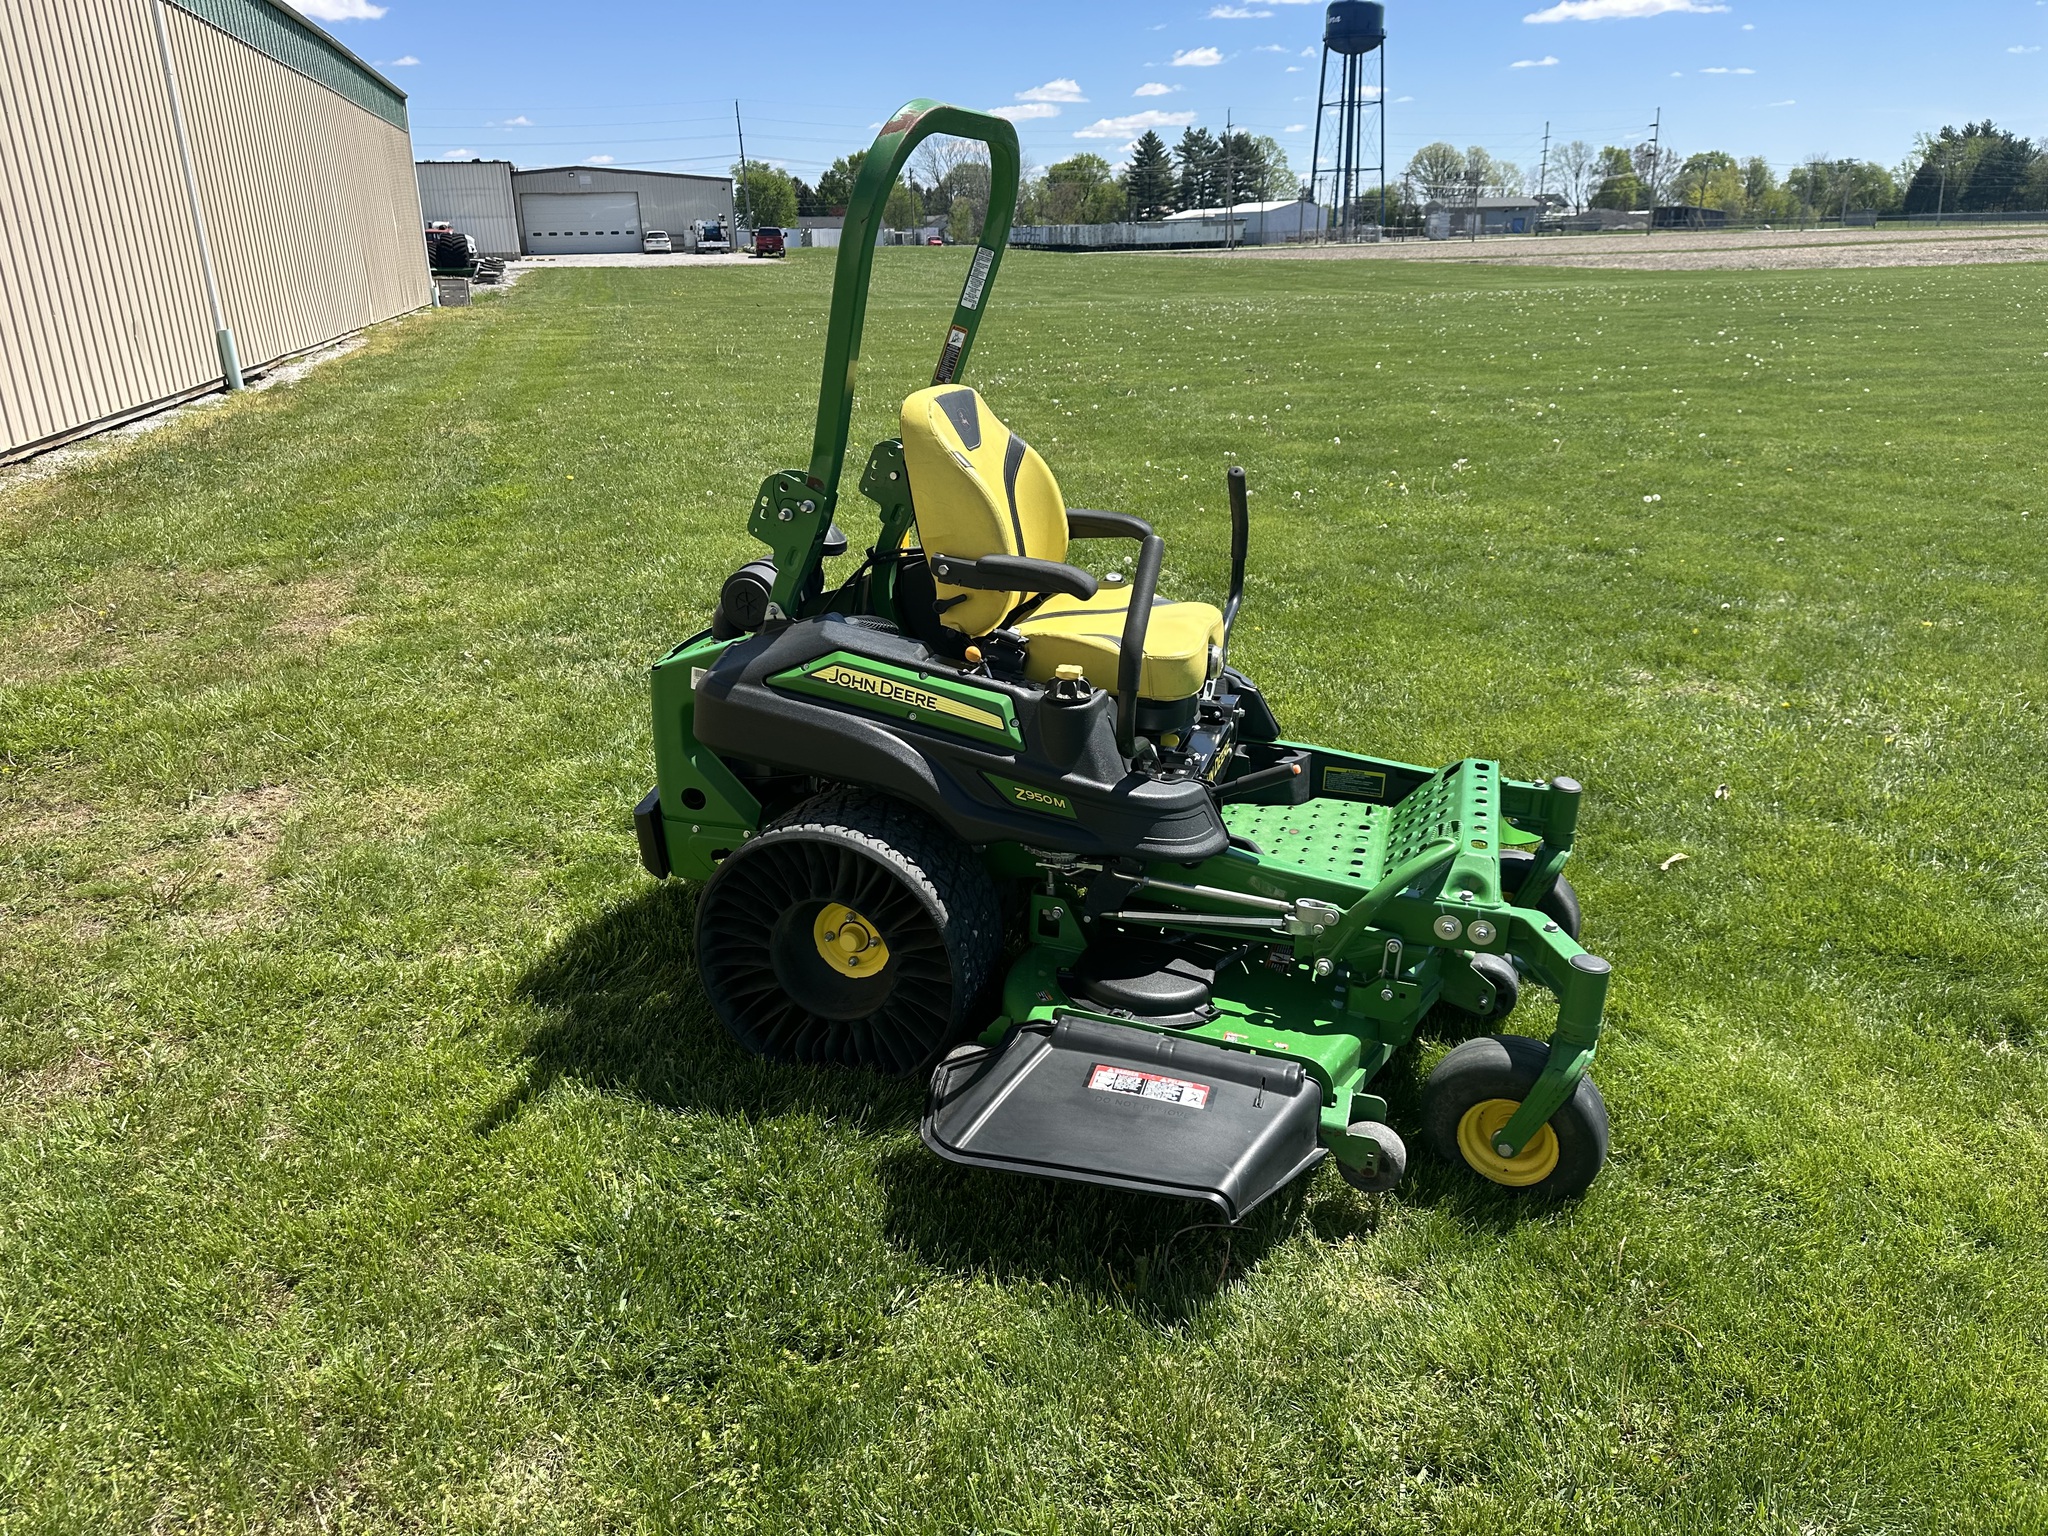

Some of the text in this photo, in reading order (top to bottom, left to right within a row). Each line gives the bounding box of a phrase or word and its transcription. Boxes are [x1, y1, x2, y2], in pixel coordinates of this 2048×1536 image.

[828, 668, 938, 710] JOHN DEERE
[1094, 1095, 1111, 1104] DO
[1114, 1099, 1137, 1109] NOT
